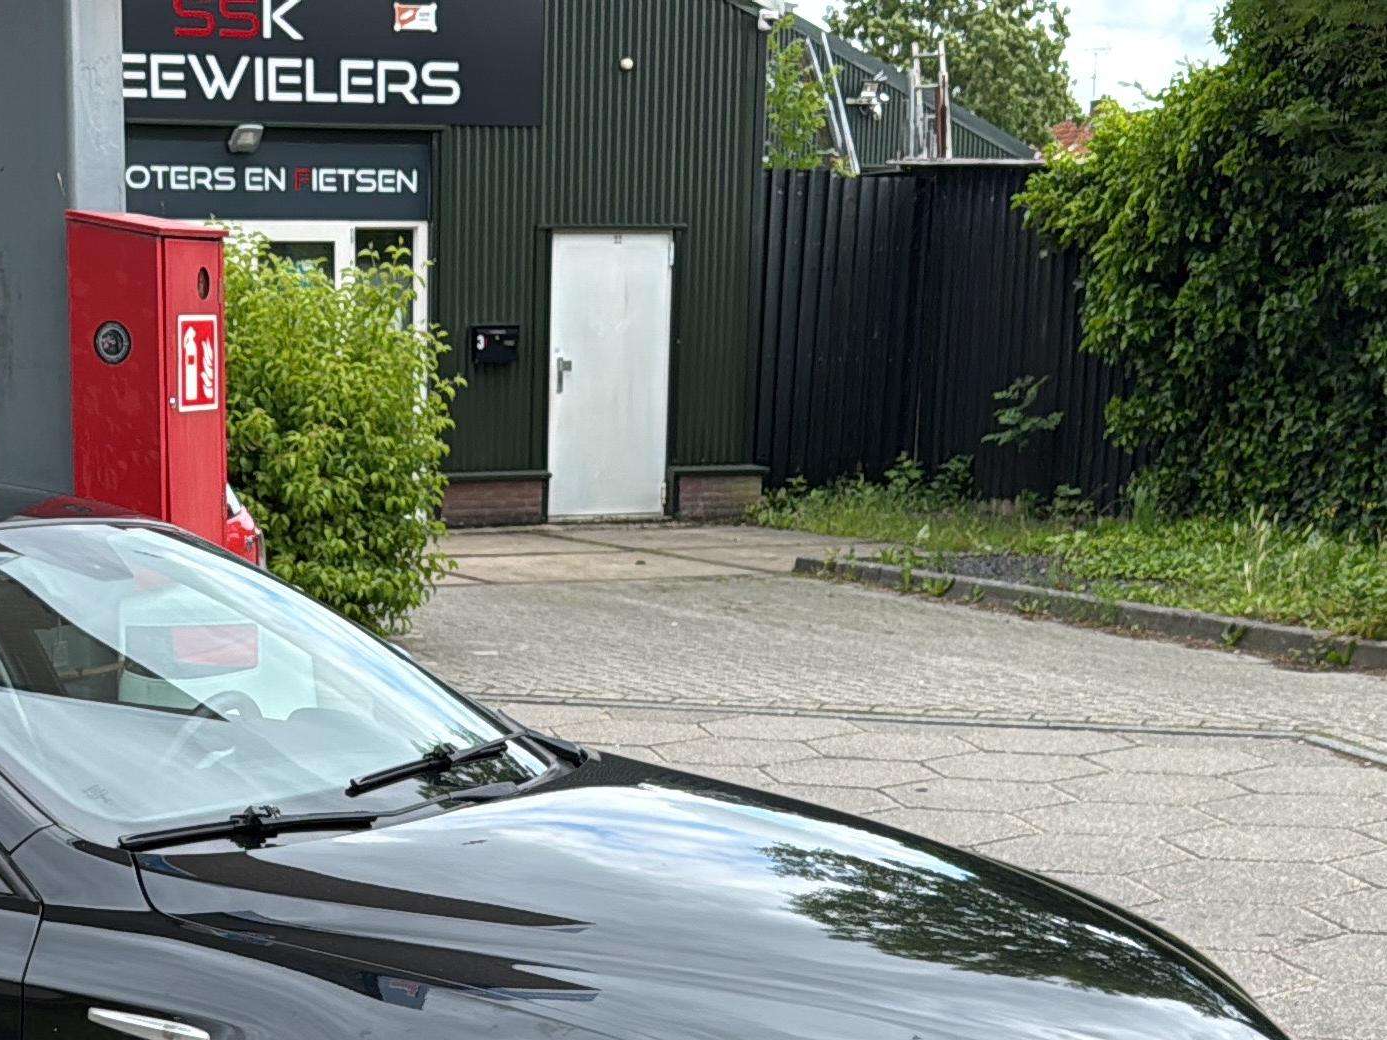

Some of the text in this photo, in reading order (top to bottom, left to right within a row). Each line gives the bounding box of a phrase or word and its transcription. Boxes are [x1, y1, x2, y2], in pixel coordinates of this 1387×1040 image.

[172, 0, 305, 41] SSK
[122, 53, 461, 105] EEWIELERS
[125, 165, 418, 194] OTERS EN FIETSEN
